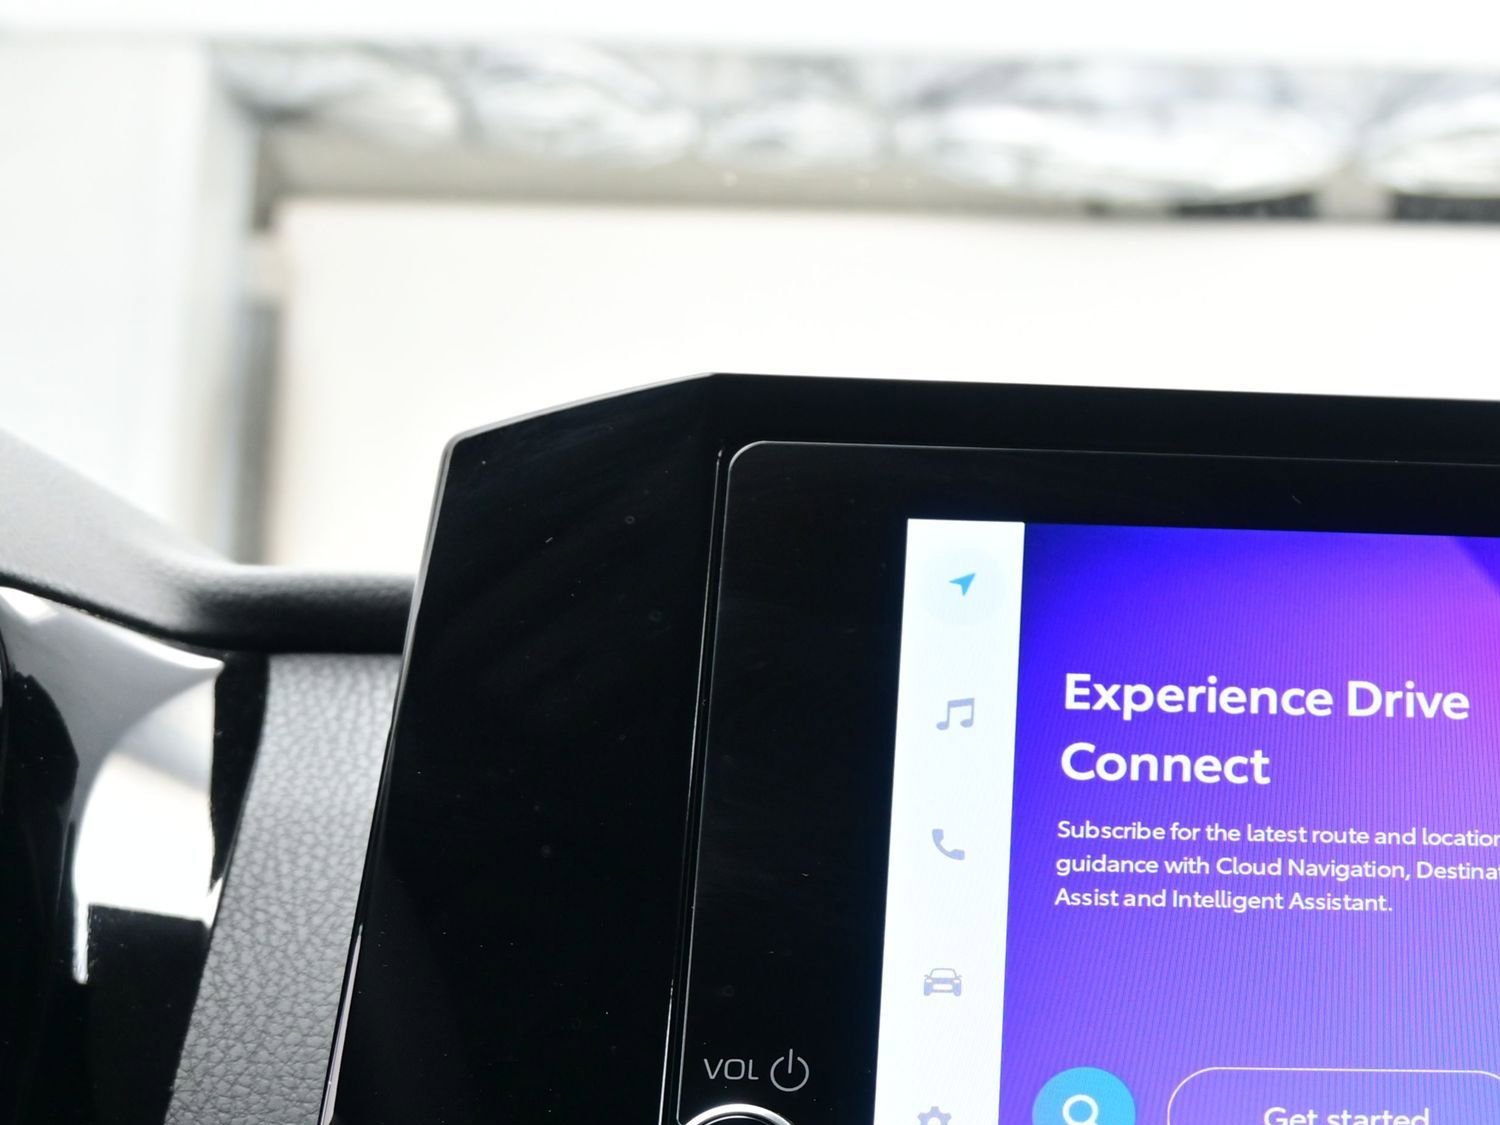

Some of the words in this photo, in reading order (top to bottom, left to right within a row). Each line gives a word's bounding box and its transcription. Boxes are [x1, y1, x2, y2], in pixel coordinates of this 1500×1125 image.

[1063, 672, 1334, 721] Experience
[1346, 680, 1470, 720] Drive
[1060, 742, 1271, 785] Connect
[1057, 820, 1166, 840] Subscribe
[1170, 822, 1201, 841] for
[1205, 823, 1241, 842] the
[1246, 824, 1308, 843] latest
[1312, 828, 1370, 845] route
[1374, 827, 1416, 846] and
[1055, 854, 1159, 876] guidance
[1164, 856, 1210, 875] with
[1215, 857, 1282, 876] Cloud
[1287, 858, 1411, 881] Navigation,
[1054, 887, 1118, 907] Assist
[1122, 889, 1167, 908] and
[1172, 889, 1284, 913] Intelligent
[1288, 892, 1393, 912] Assistant.
[704, 1058, 760, 1080] VOL
